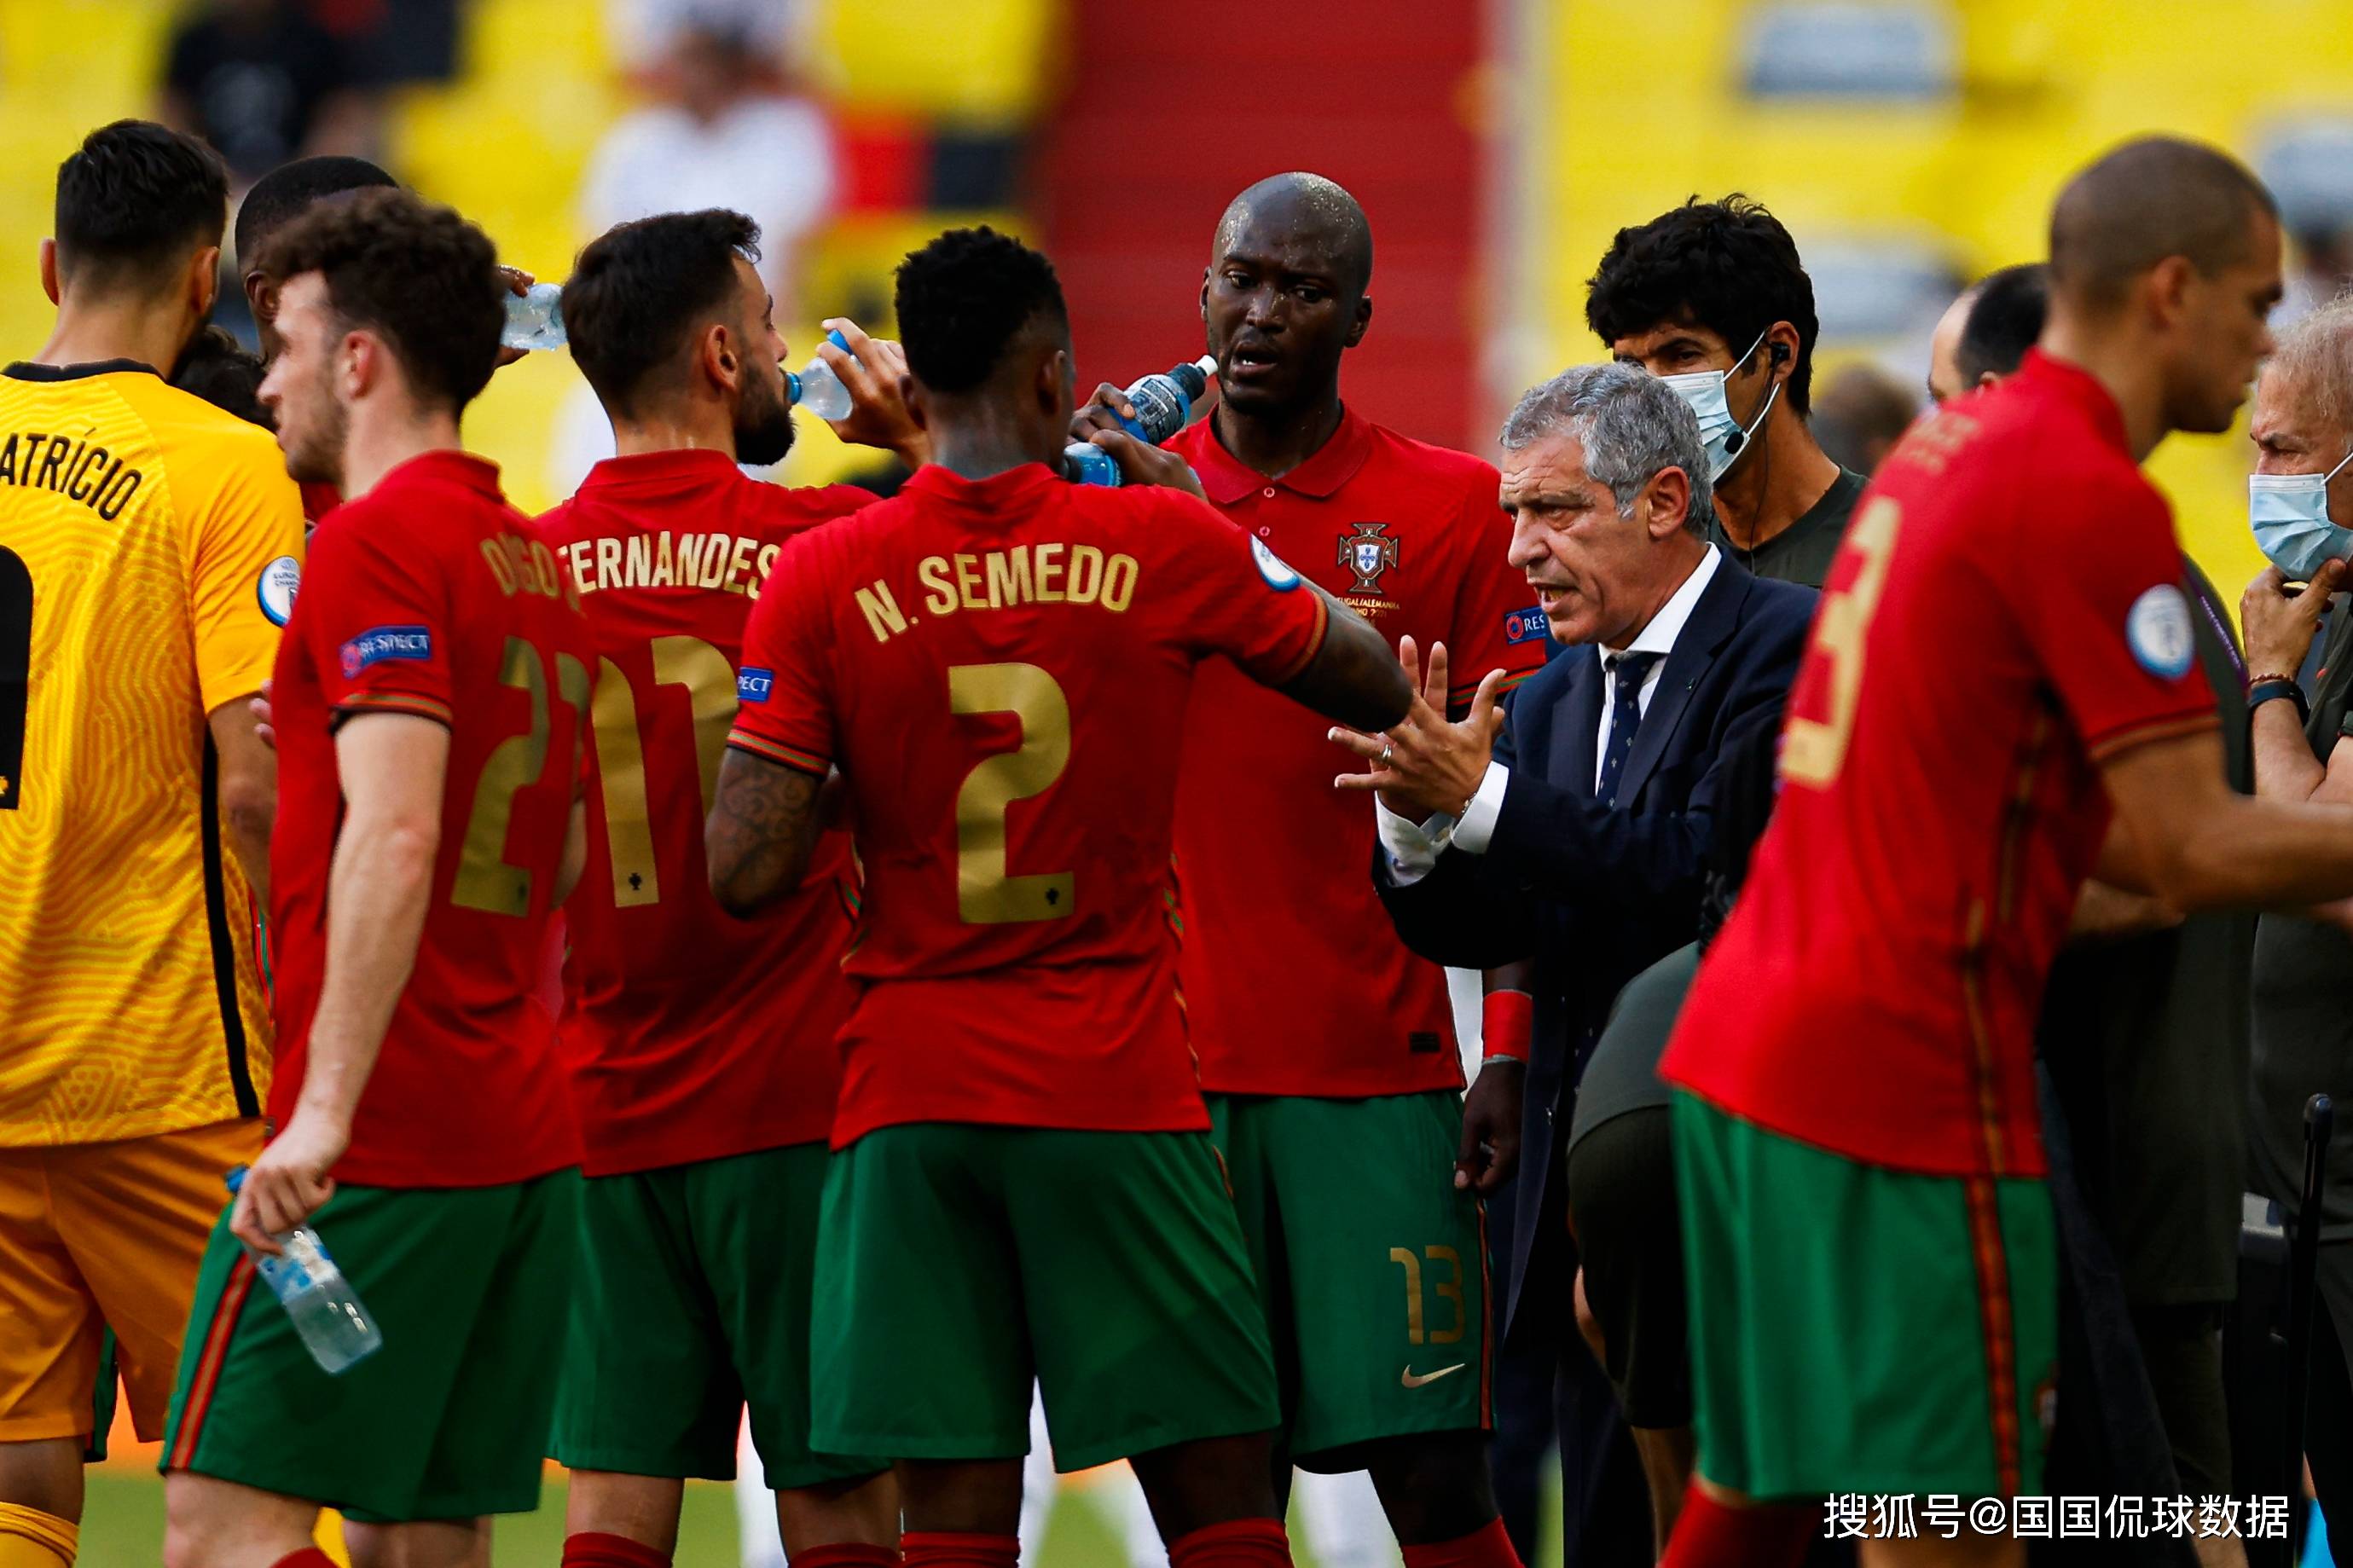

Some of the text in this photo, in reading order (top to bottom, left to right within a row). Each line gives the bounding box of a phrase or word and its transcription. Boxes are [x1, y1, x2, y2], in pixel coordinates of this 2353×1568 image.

[855, 543, 1139, 644] N. SEMEDO
[1776, 495, 1902, 790] 3
[590, 635, 739, 908] 17
[948, 662, 1075, 924] 2
[1389, 1245, 1464, 1345] 13
